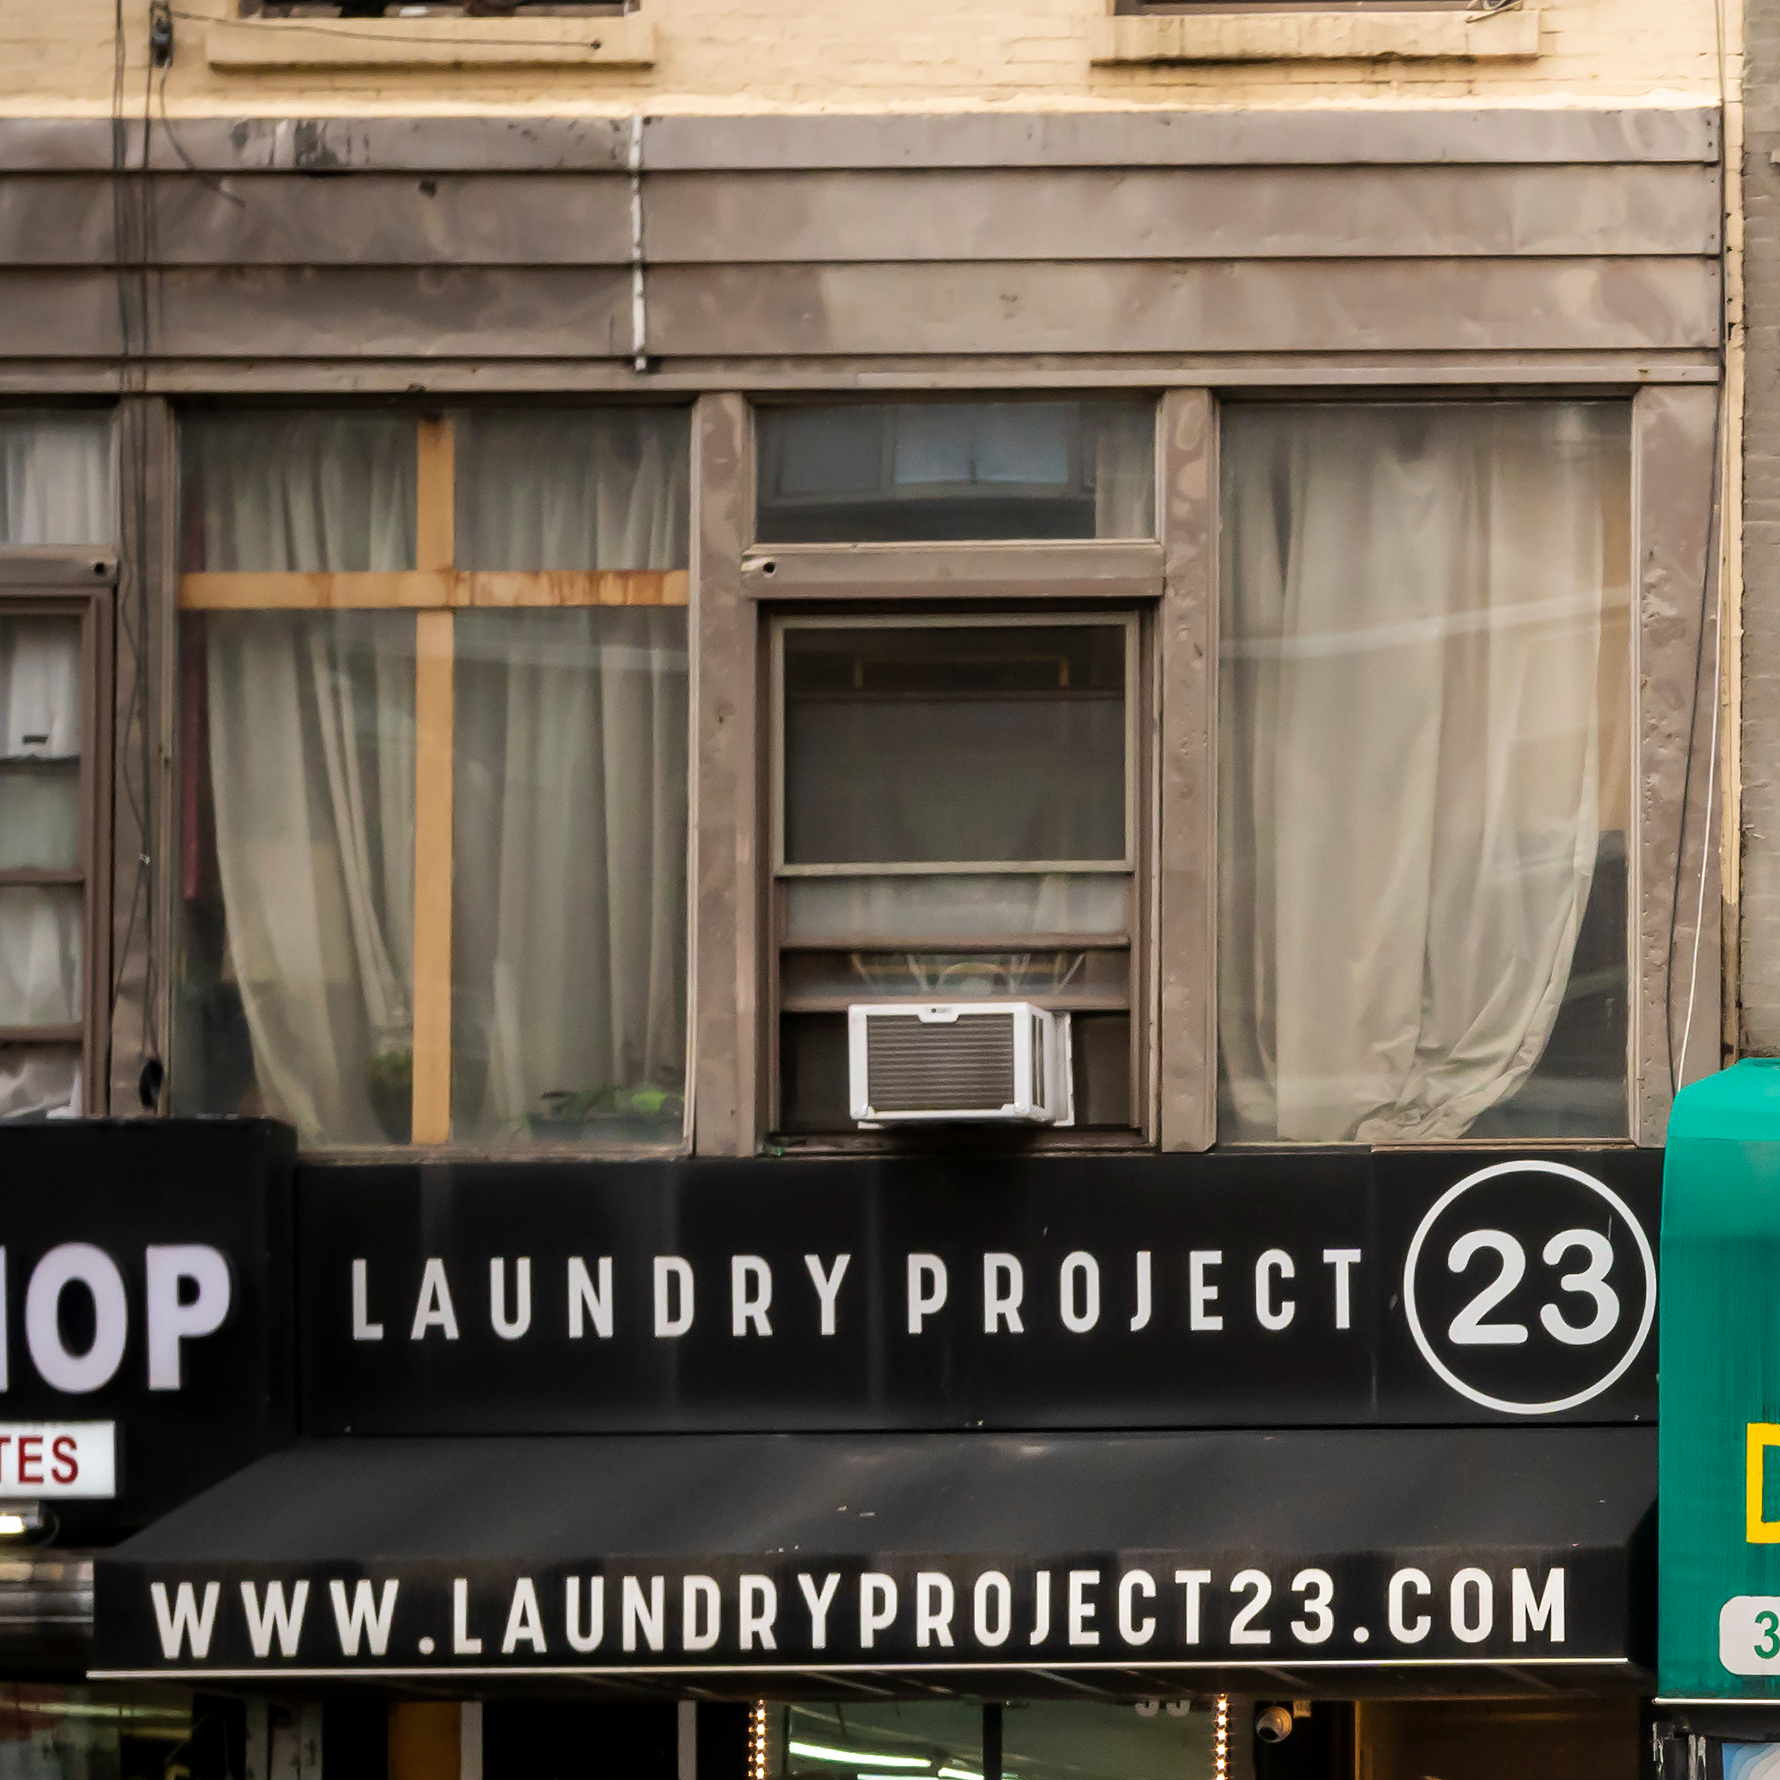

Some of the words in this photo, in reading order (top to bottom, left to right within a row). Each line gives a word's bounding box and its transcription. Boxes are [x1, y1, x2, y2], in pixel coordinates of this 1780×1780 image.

[0, 1242, 231, 1393] OP
[352, 1253, 851, 1341] LAUNDRY
[908, 1249, 1362, 1335] PROJECT
[1448, 1229, 1620, 1345] 23
[151, 1566, 1566, 1659] WWW.LAUNDRYPROJECT23.COM
